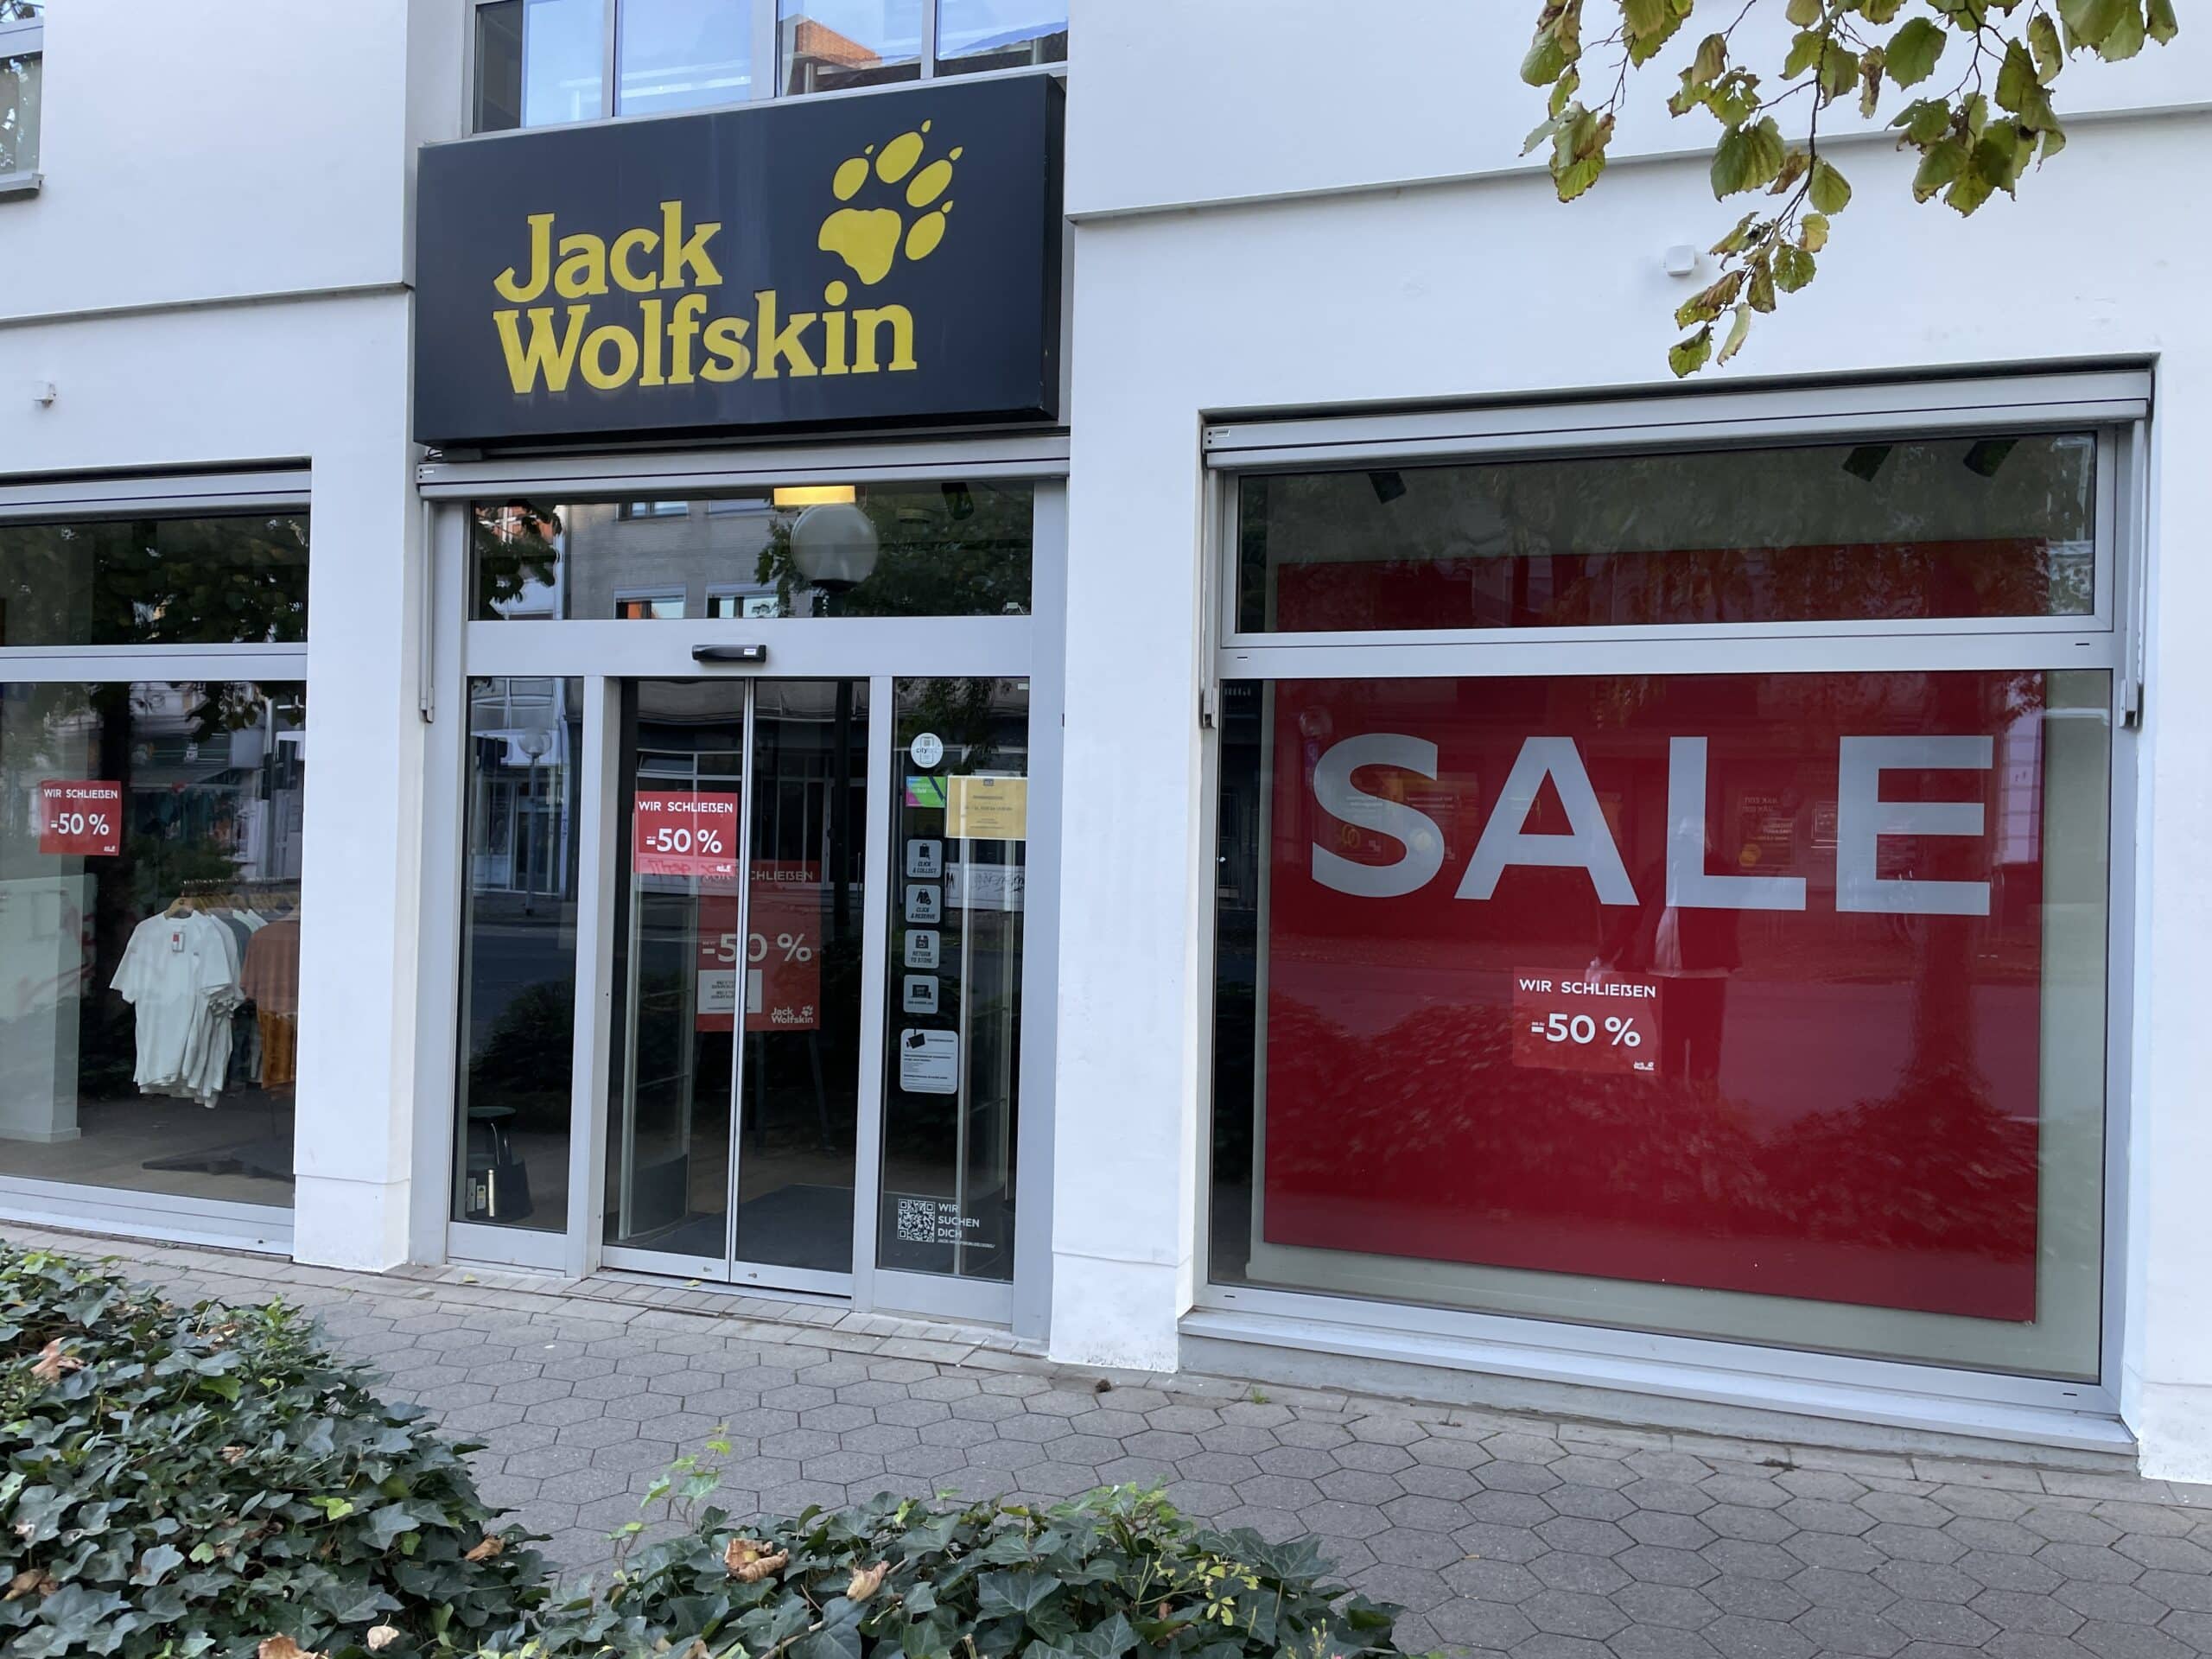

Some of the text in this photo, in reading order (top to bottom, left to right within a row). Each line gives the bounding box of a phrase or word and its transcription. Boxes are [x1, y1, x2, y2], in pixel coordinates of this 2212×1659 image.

[493, 200, 722, 302] Jack
[493, 281, 918, 394] Wolfskin
[44, 789, 62, 798] WIR
[639, 801, 661, 811] WIR
[50, 812, 110, 836] -50 %
[1312, 733, 1994, 916] SALE
[646, 828, 722, 854] -50 %
[778, 933, 812, 963] %
[1519, 979, 1552, 992] WIR
[772, 1007, 794, 1016] Jack
[771, 1014, 814, 1025] Wolfskin
[1531, 1013, 1641, 1047] -50 %
[938, 1203, 959, 1213] WIR
[938, 1216, 980, 1228] SUCHEN
[938, 1228, 962, 1238] DICH
